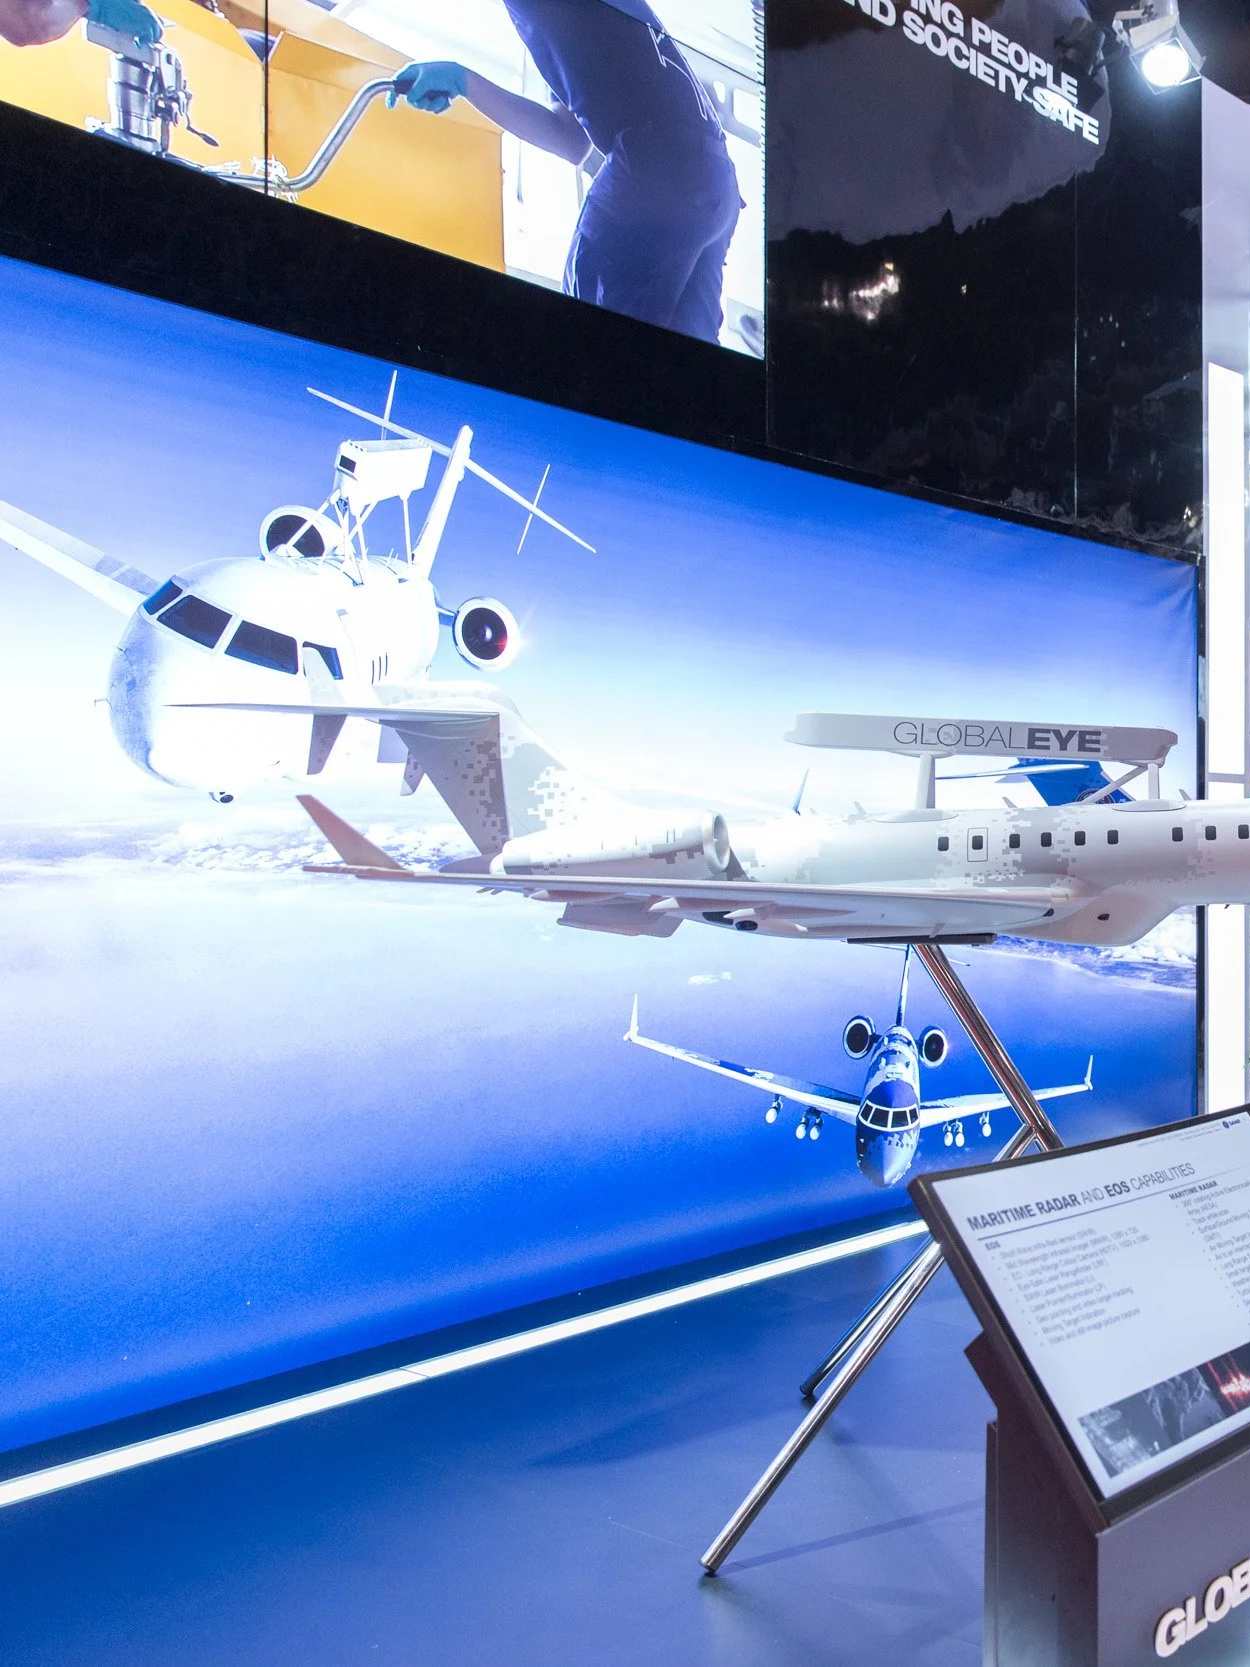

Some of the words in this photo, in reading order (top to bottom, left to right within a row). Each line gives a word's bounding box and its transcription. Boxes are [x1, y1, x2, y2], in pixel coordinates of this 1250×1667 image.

[903, 10, 1028, 102] SOCIETY
[1032, 85, 1099, 145] SAFE
[972, 17, 1078, 104] PEOPLE
[893, 721, 1101, 753] GLOBALEYE
[967, 1204, 1035, 1229] MARITIME
[1035, 1194, 1080, 1214] RADAR
[1080, 1187, 1104, 1204] AND
[1104, 1181, 1130, 1197] EOS
[1130, 1163, 1195, 1190] CAPABILITIES
[1169, 1186, 1198, 1200] MARITIME
[1197, 1180, 1218, 1191] RADAR
